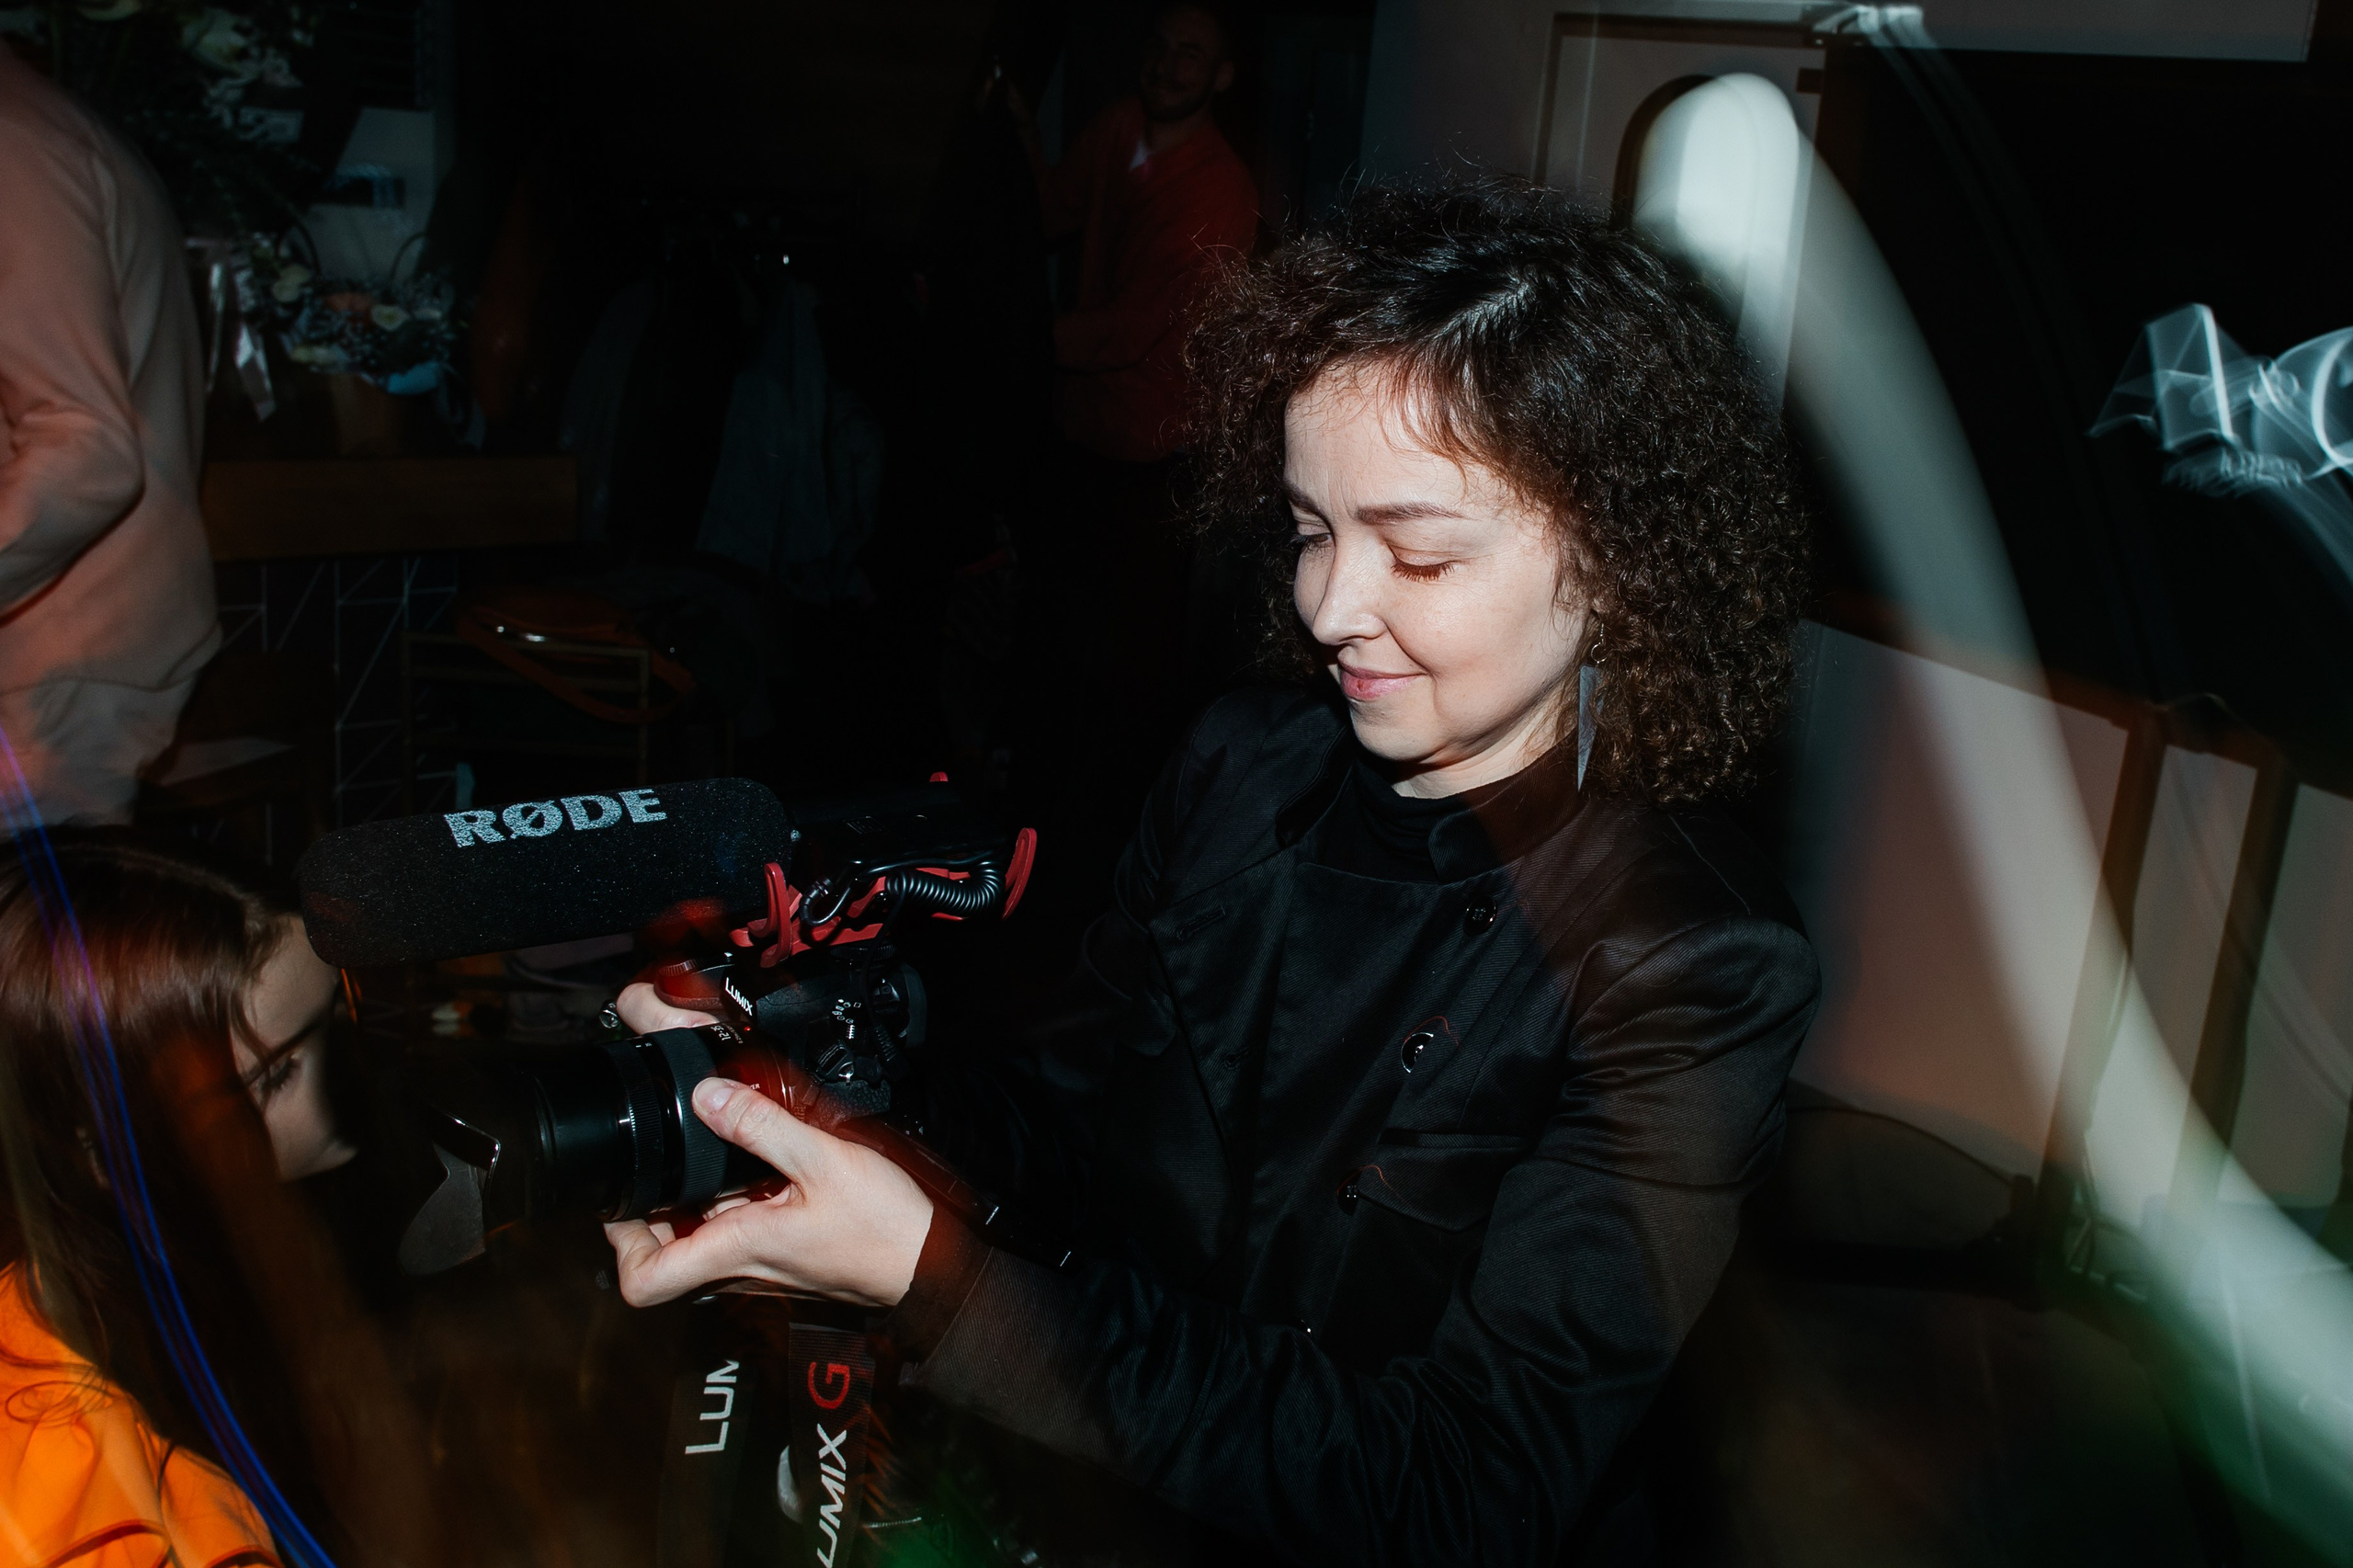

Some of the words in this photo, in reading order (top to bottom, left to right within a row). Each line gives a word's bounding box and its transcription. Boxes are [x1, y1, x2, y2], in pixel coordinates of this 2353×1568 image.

[443, 788, 668, 848] RØDE
[724, 976, 754, 1017] LUMIX
[685, 1359, 740, 1454] LUM
[807, 1361, 850, 1410] G
[816, 1423, 847, 1568] UMIX
